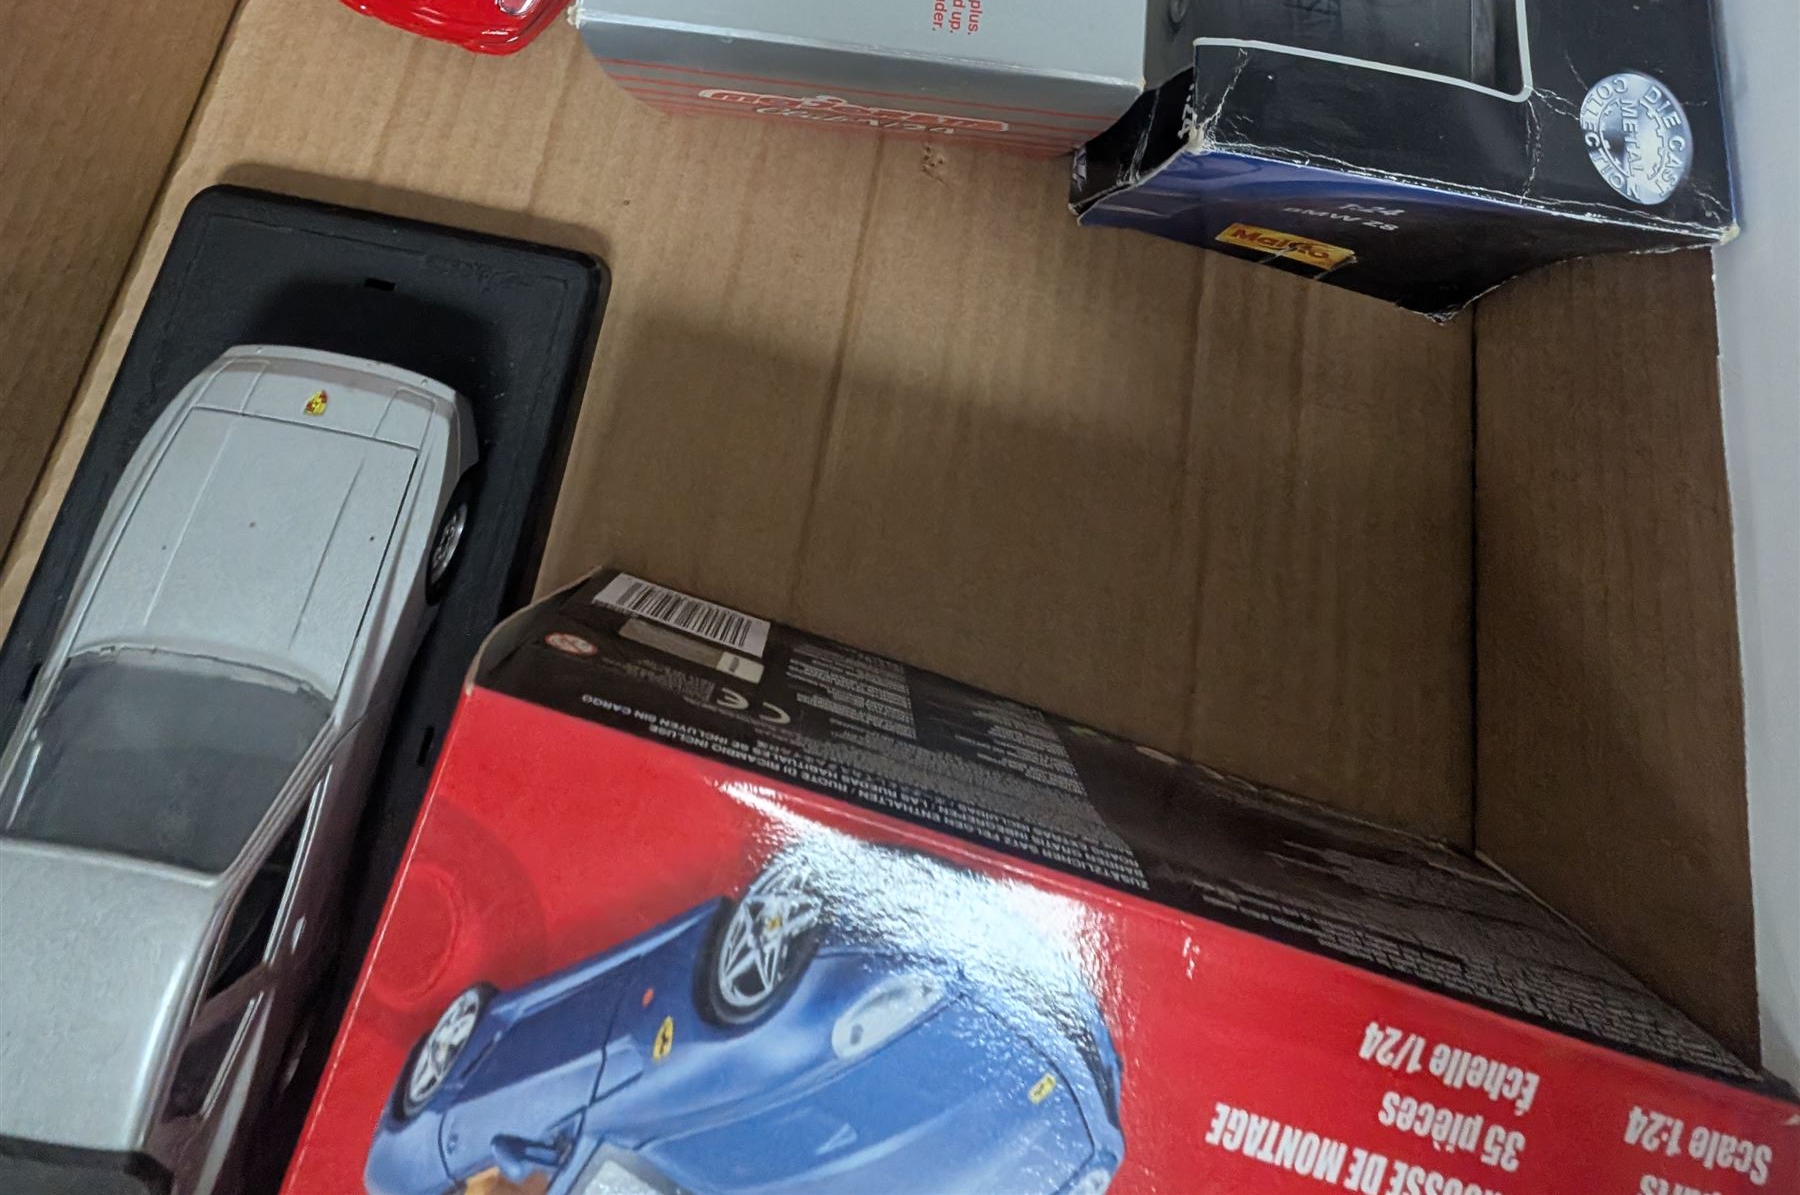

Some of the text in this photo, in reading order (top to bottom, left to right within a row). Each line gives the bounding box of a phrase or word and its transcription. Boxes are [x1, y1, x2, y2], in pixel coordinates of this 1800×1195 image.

[948, 11, 961, 34] up.
[967, 0, 983, 36] plus.
[1581, 76, 1641, 201] COLLECTION
[1620, 99, 1644, 176] METAL
[1643, 84, 1686, 197] DIE CAST
[1360, 1022, 1539, 1116] Échelle 1/24
[1205, 1103, 1347, 1185] MONTAGE
[1379, 1092, 1525, 1171] 35 pièces
[1624, 1106, 1772, 1185] Scale 1:24
[1344, 1148, 1388, 1195] DE
